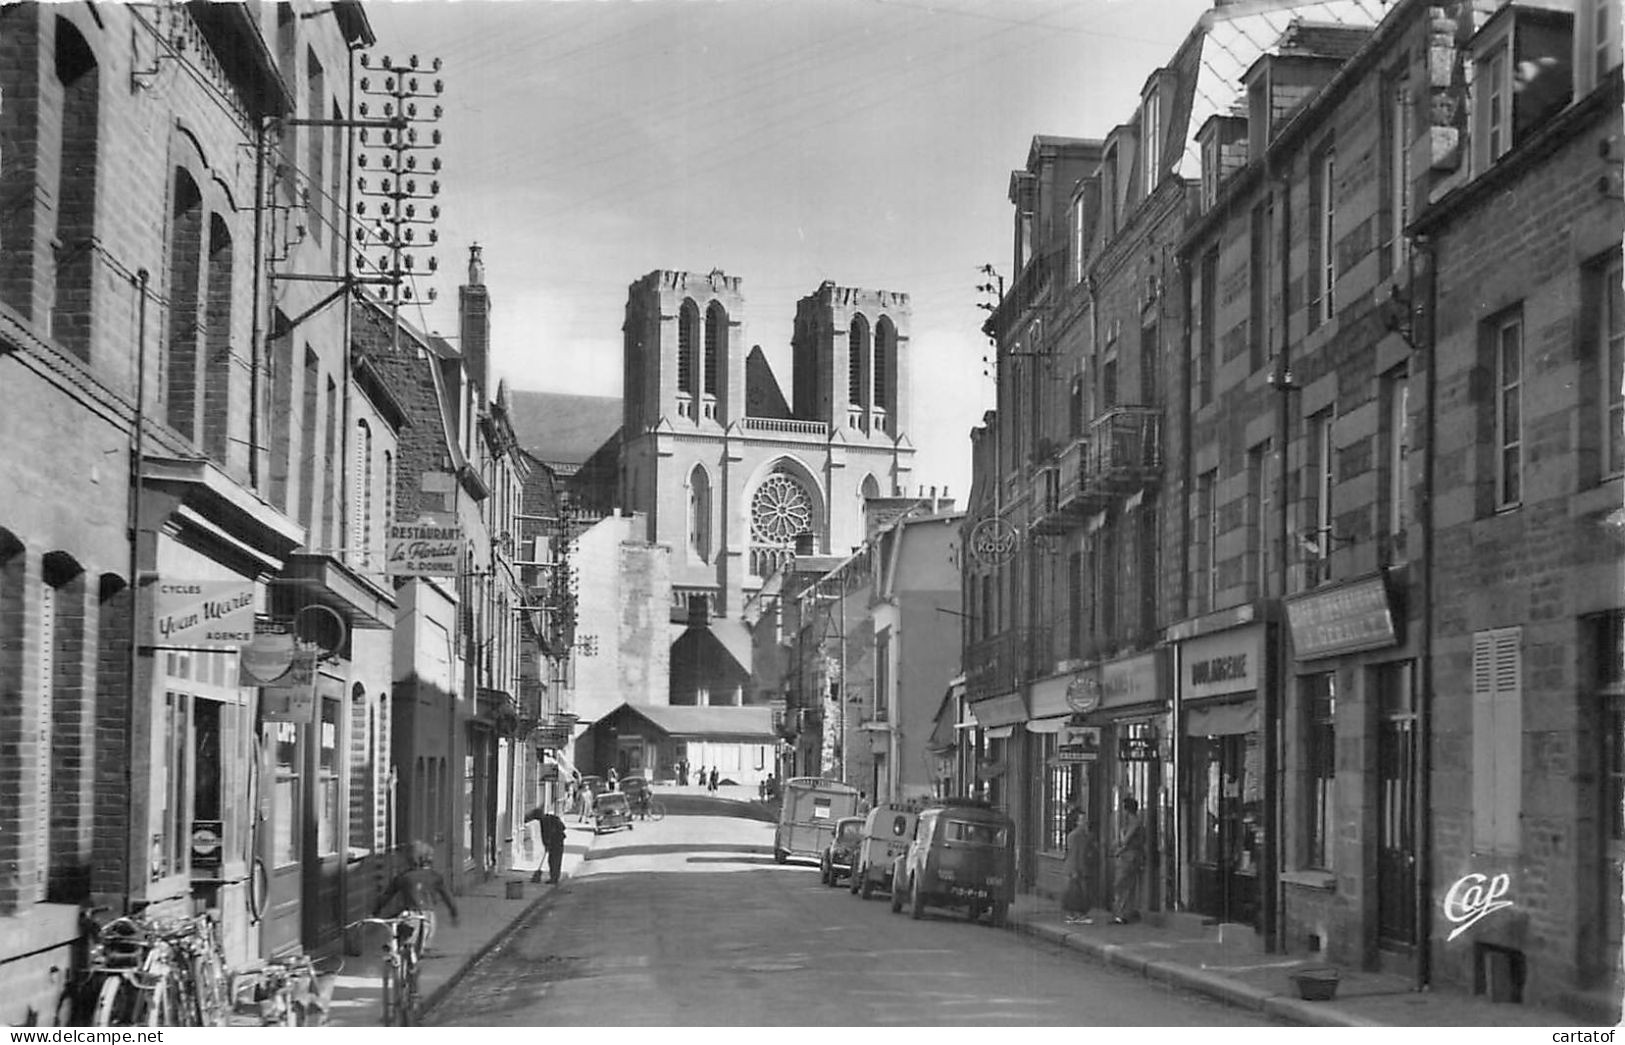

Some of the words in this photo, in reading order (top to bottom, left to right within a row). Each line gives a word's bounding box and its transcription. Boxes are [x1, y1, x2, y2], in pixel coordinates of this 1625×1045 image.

[391, 527, 461, 540] RESTAURANT
[161, 585, 201, 595] CYCLES
[159, 614, 198, 640] Yvan
[203, 592, 253, 620] Marie
[206, 632, 250, 641] AGENCE
